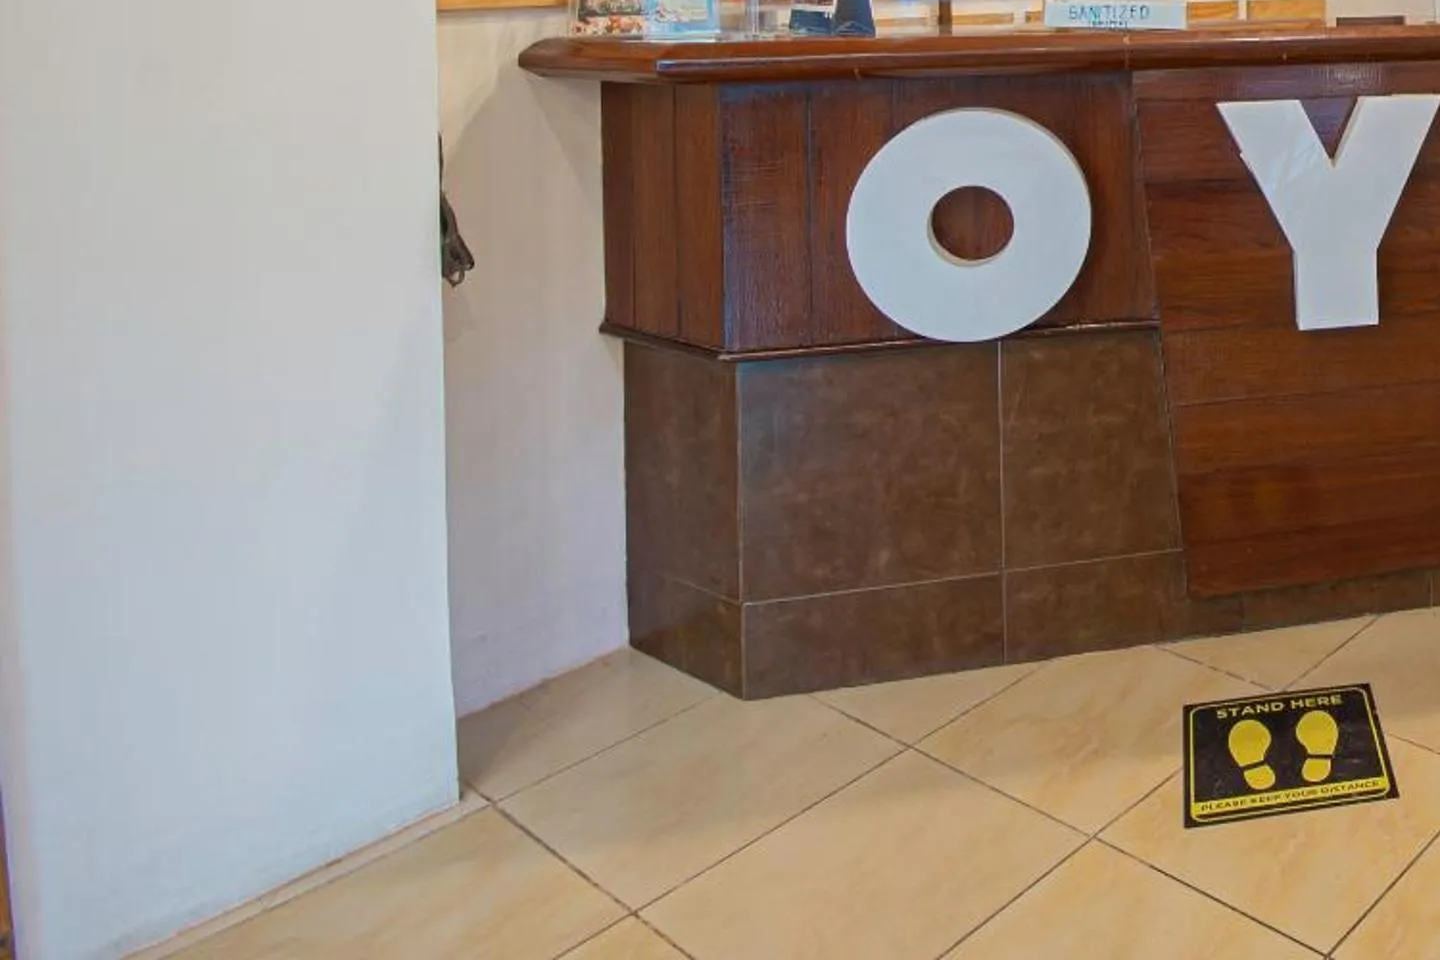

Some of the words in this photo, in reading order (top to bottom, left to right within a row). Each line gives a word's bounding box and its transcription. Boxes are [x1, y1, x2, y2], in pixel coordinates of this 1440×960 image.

[1216, 701, 1284, 719] STAND
[1291, 694, 1344, 710] HERE
[1201, 798, 1246, 812] PLEASE
[1251, 793, 1282, 805] KEEP
[1319, 780, 1380, 794] DISTANCE
